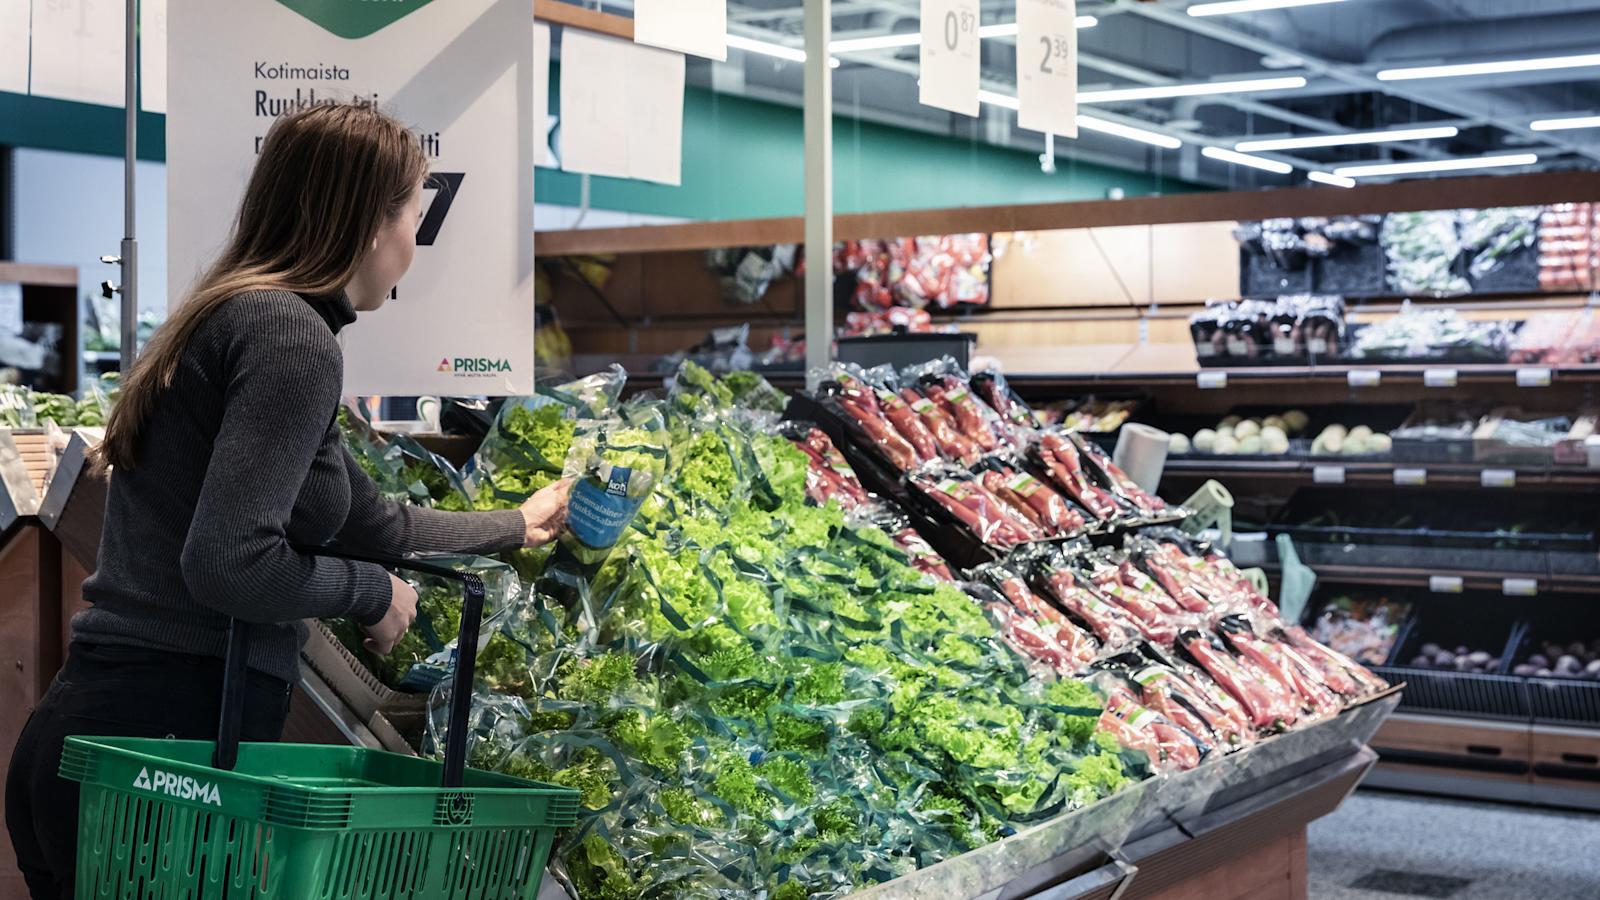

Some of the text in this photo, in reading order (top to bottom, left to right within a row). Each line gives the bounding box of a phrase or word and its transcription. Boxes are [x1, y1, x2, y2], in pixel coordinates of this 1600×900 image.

[254, 61, 350, 81] Kotimaista
[454, 358, 512, 372] PRISMA
[152, 769, 222, 807] PRISMA
